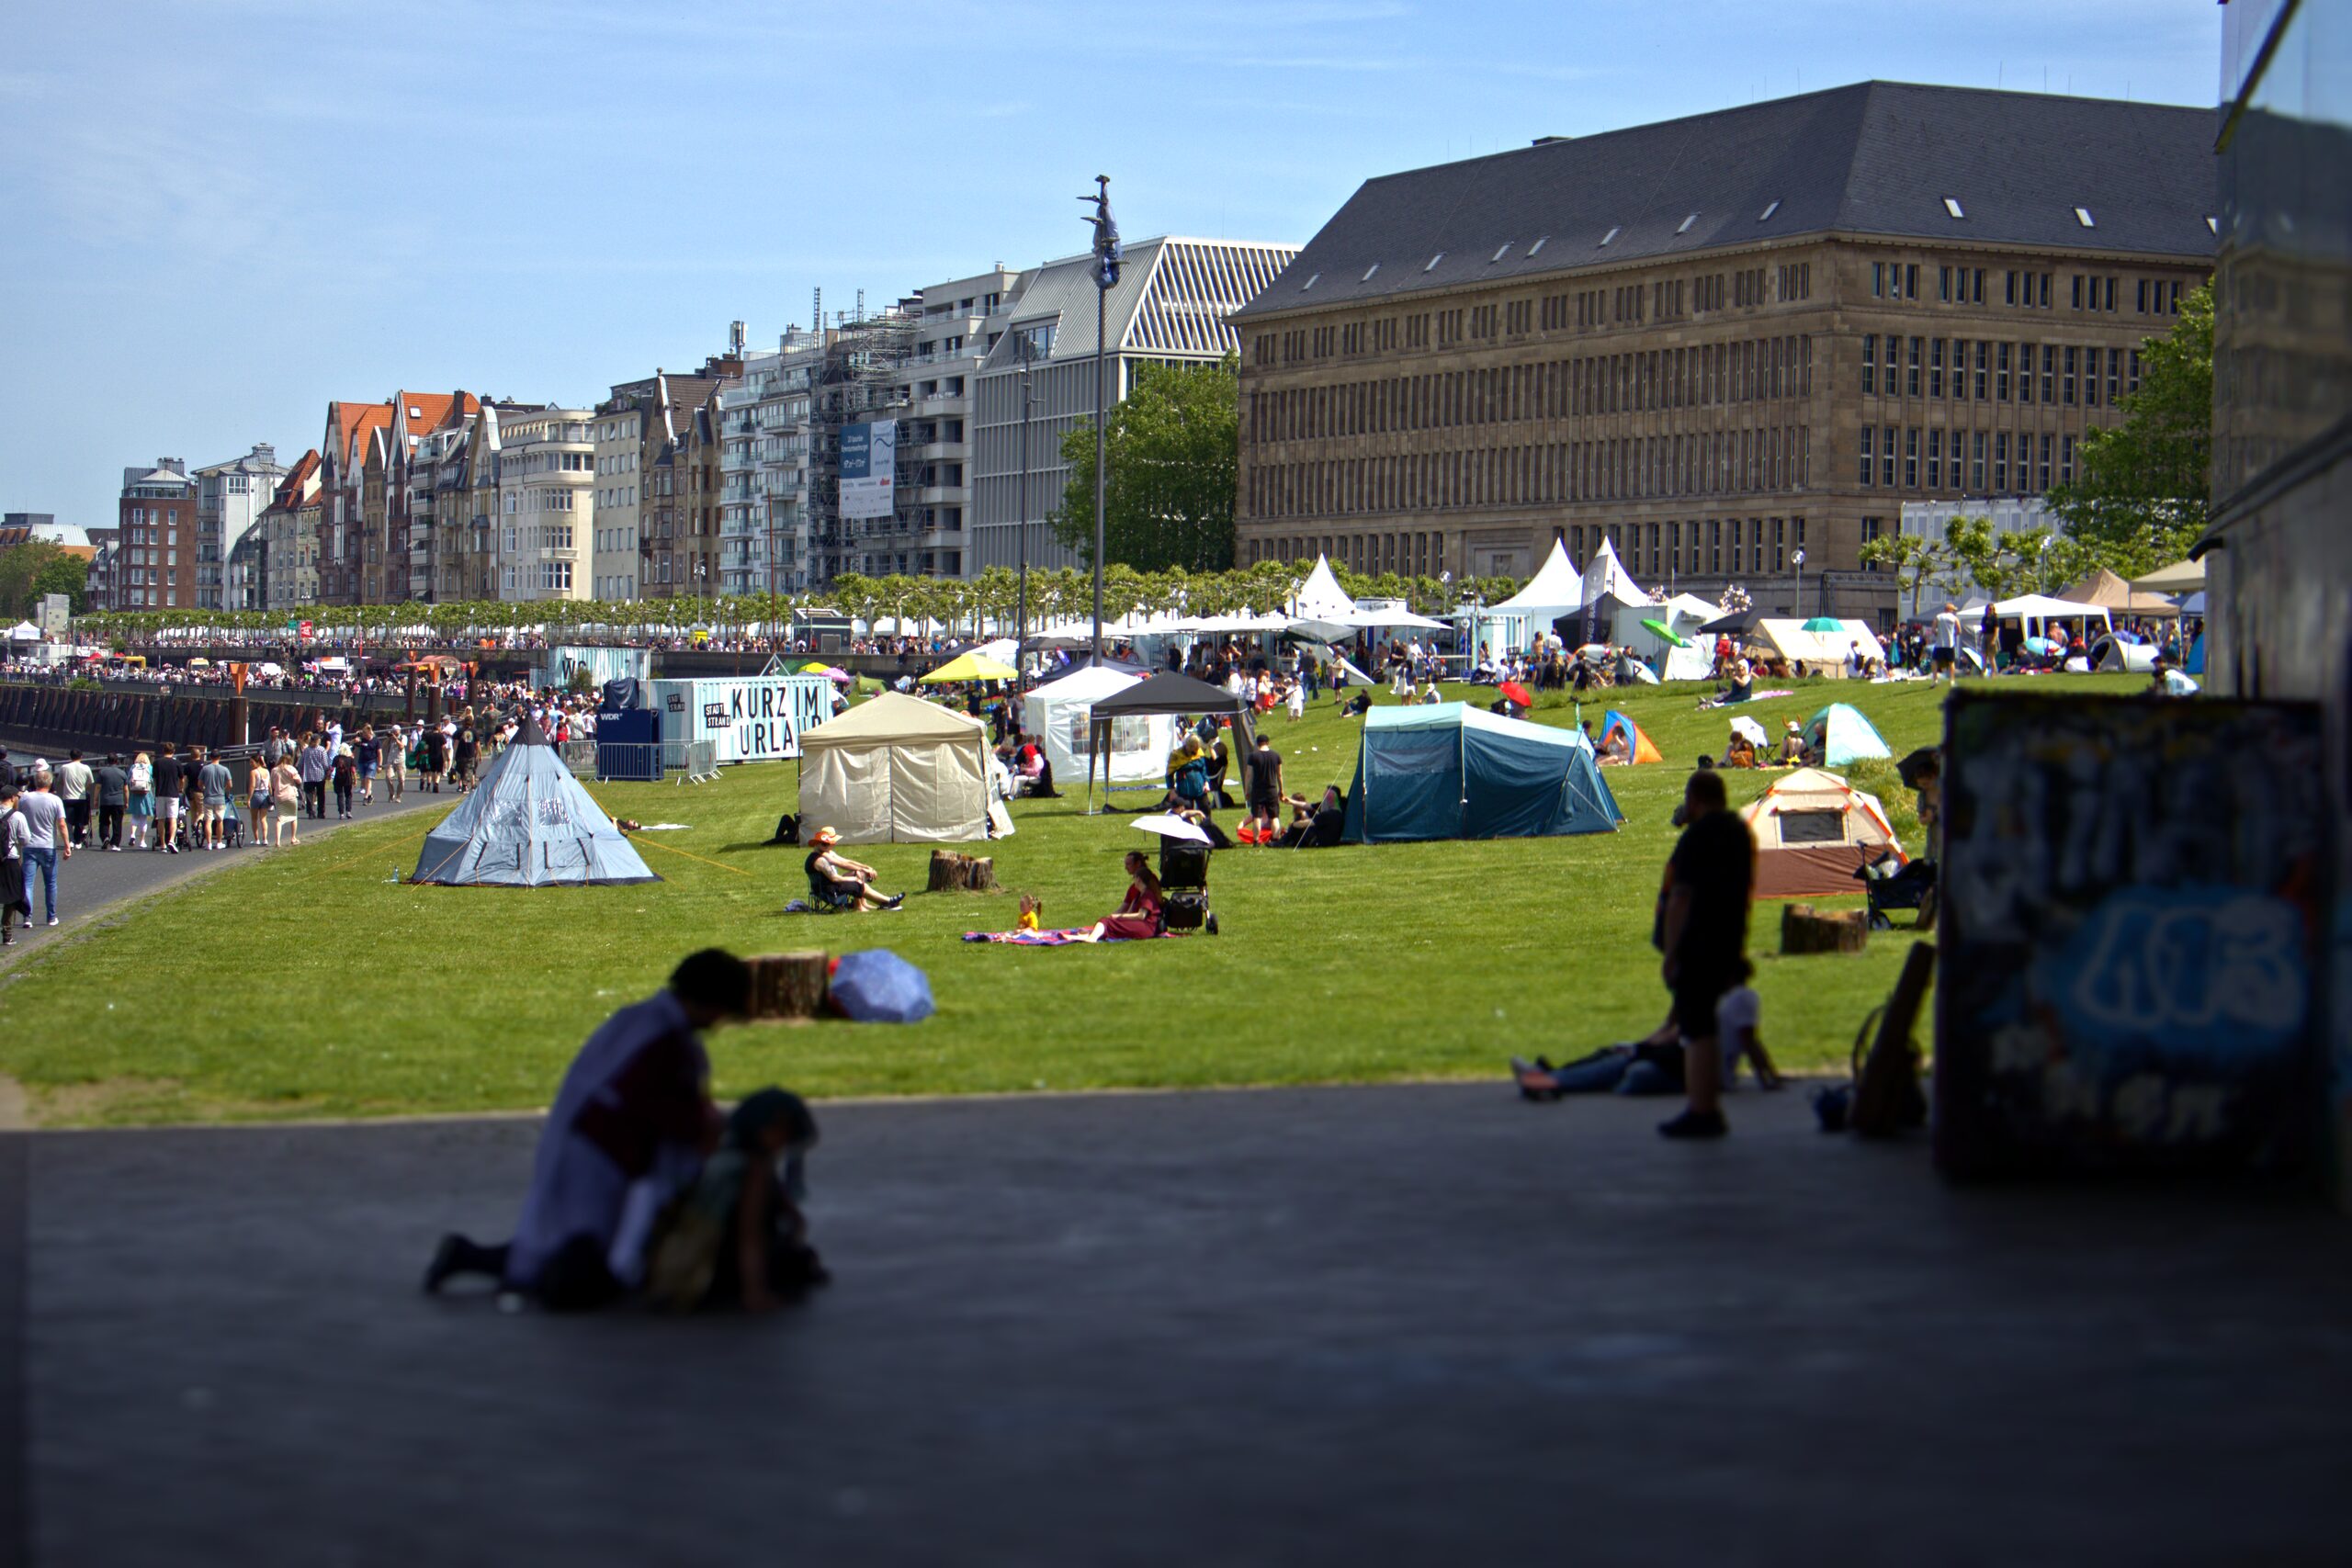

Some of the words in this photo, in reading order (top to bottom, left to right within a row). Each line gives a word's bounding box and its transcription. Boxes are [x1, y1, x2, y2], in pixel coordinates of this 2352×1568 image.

[732, 687, 786, 718] KURZ
[796, 686, 818, 716] IM
[706, 704, 723, 716] STADT
[707, 716, 729, 727] STRAND
